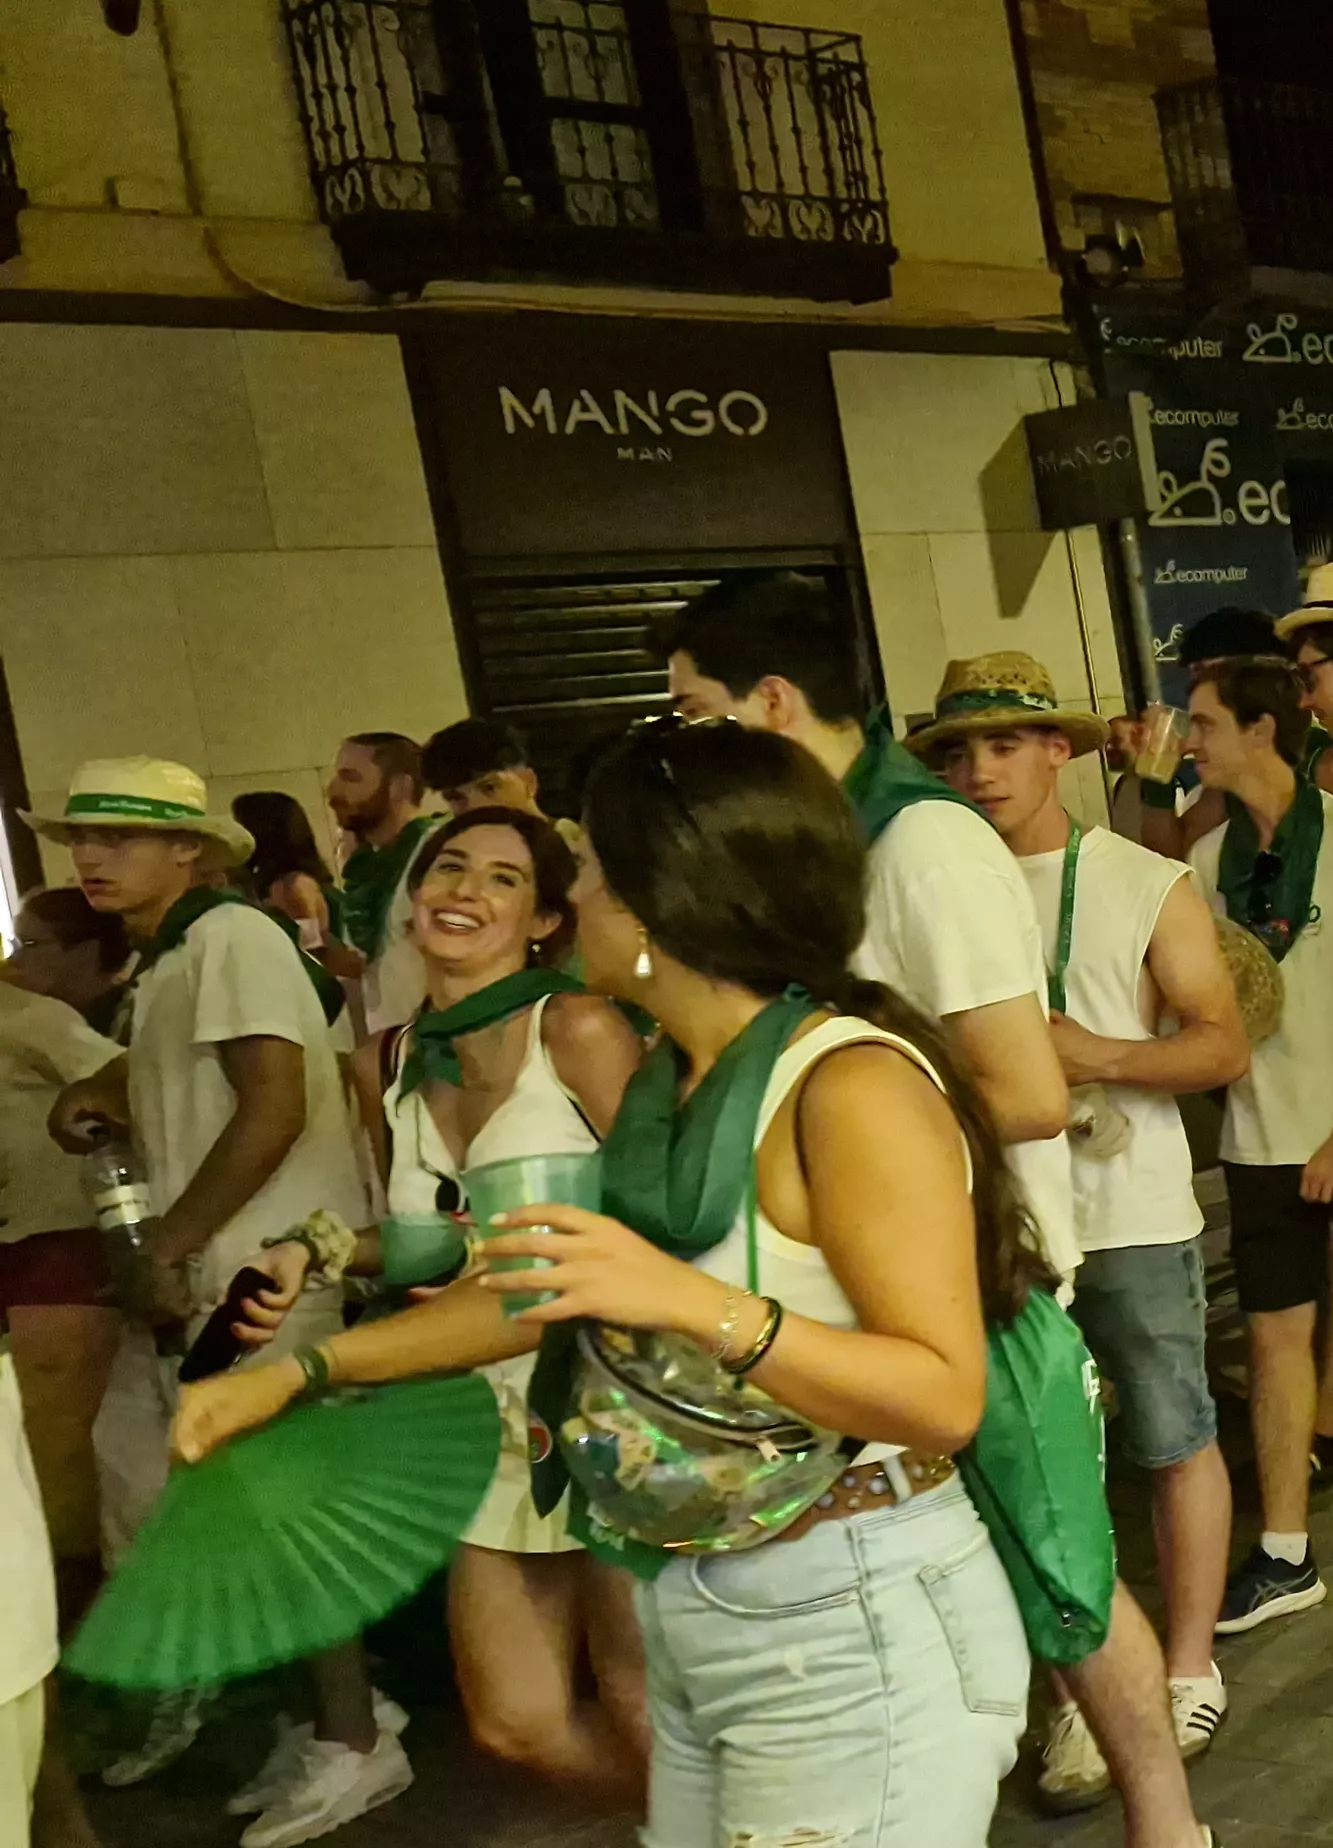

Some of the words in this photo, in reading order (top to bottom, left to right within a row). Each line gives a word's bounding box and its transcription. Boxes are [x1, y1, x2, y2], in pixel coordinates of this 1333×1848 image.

[499, 386, 768, 436] MANGO
[617, 445, 673, 462] MAN
[1037, 434, 1132, 474] MANGO
